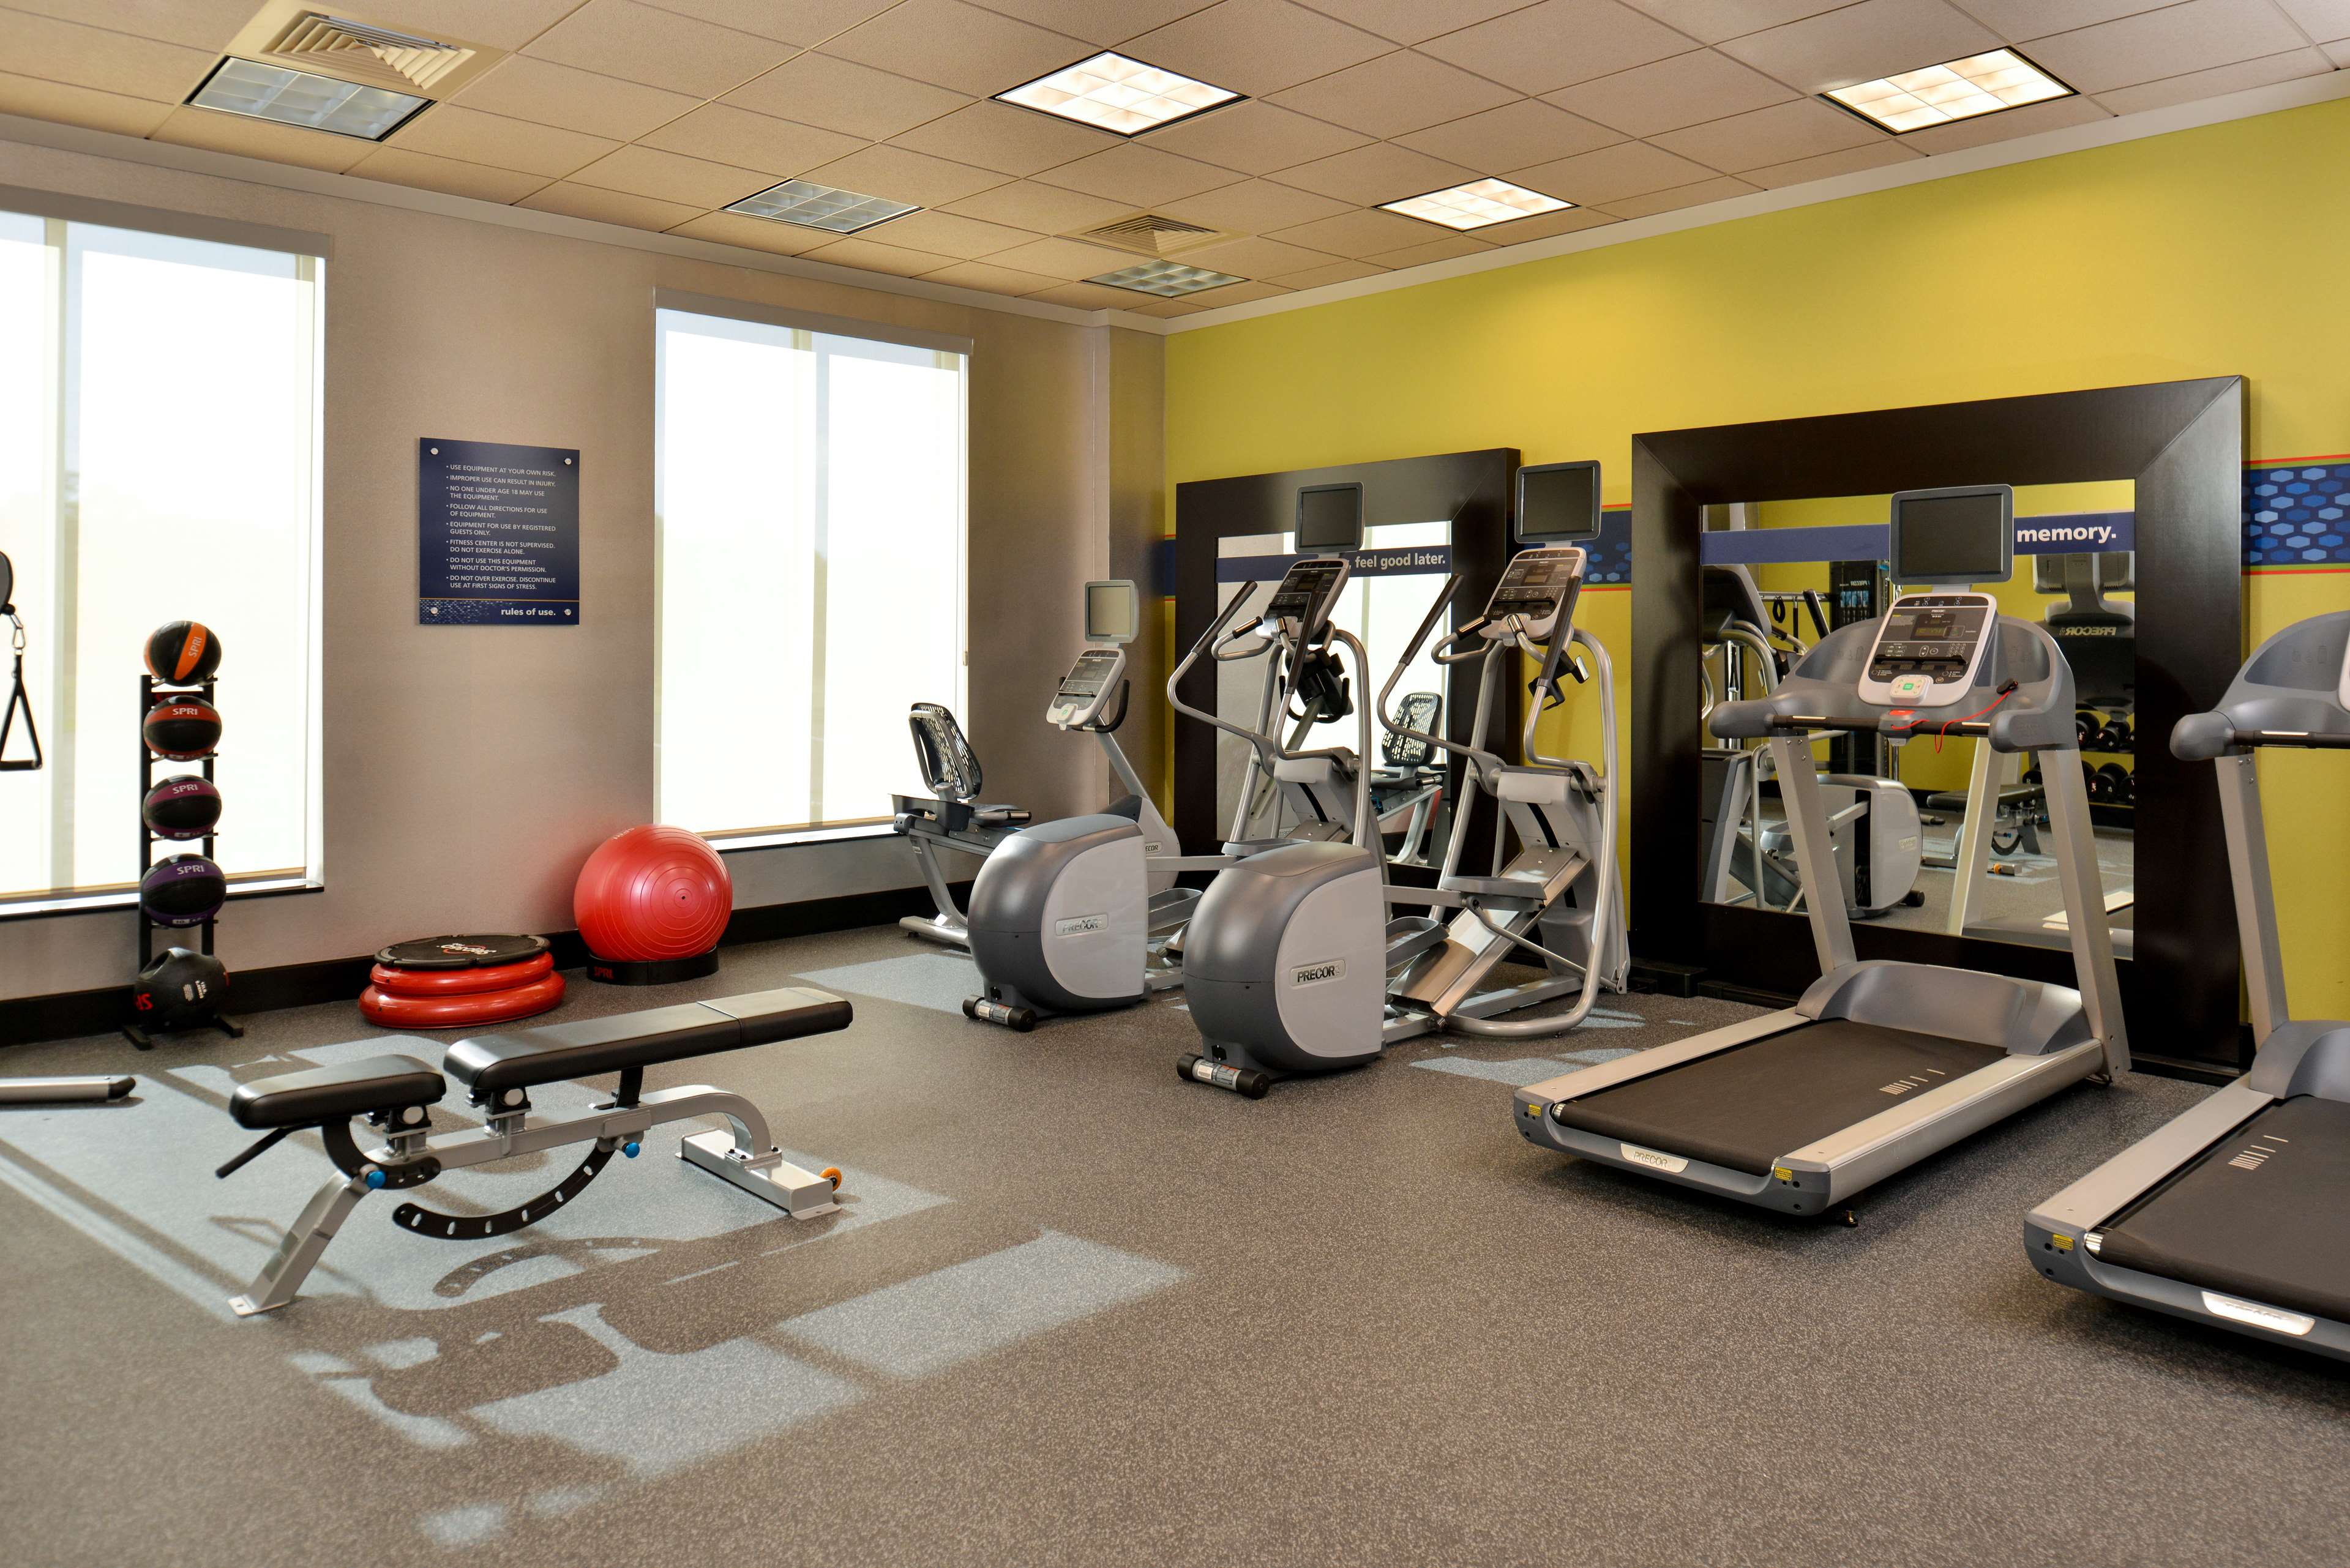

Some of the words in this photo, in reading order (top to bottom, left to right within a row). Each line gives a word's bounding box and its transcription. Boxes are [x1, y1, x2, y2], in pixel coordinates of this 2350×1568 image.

[2017, 526, 2116, 543] memory.
[1355, 555, 1377, 568] feel
[1380, 553, 1411, 570] good
[1415, 553, 1445, 566] later.
[189, 637, 203, 657] SPRI
[172, 784, 198, 794] SPRI
[176, 865, 205, 875] SPRI
[1297, 965, 1335, 982] PRECOR
[1634, 1151, 1668, 1167] PRECOR
